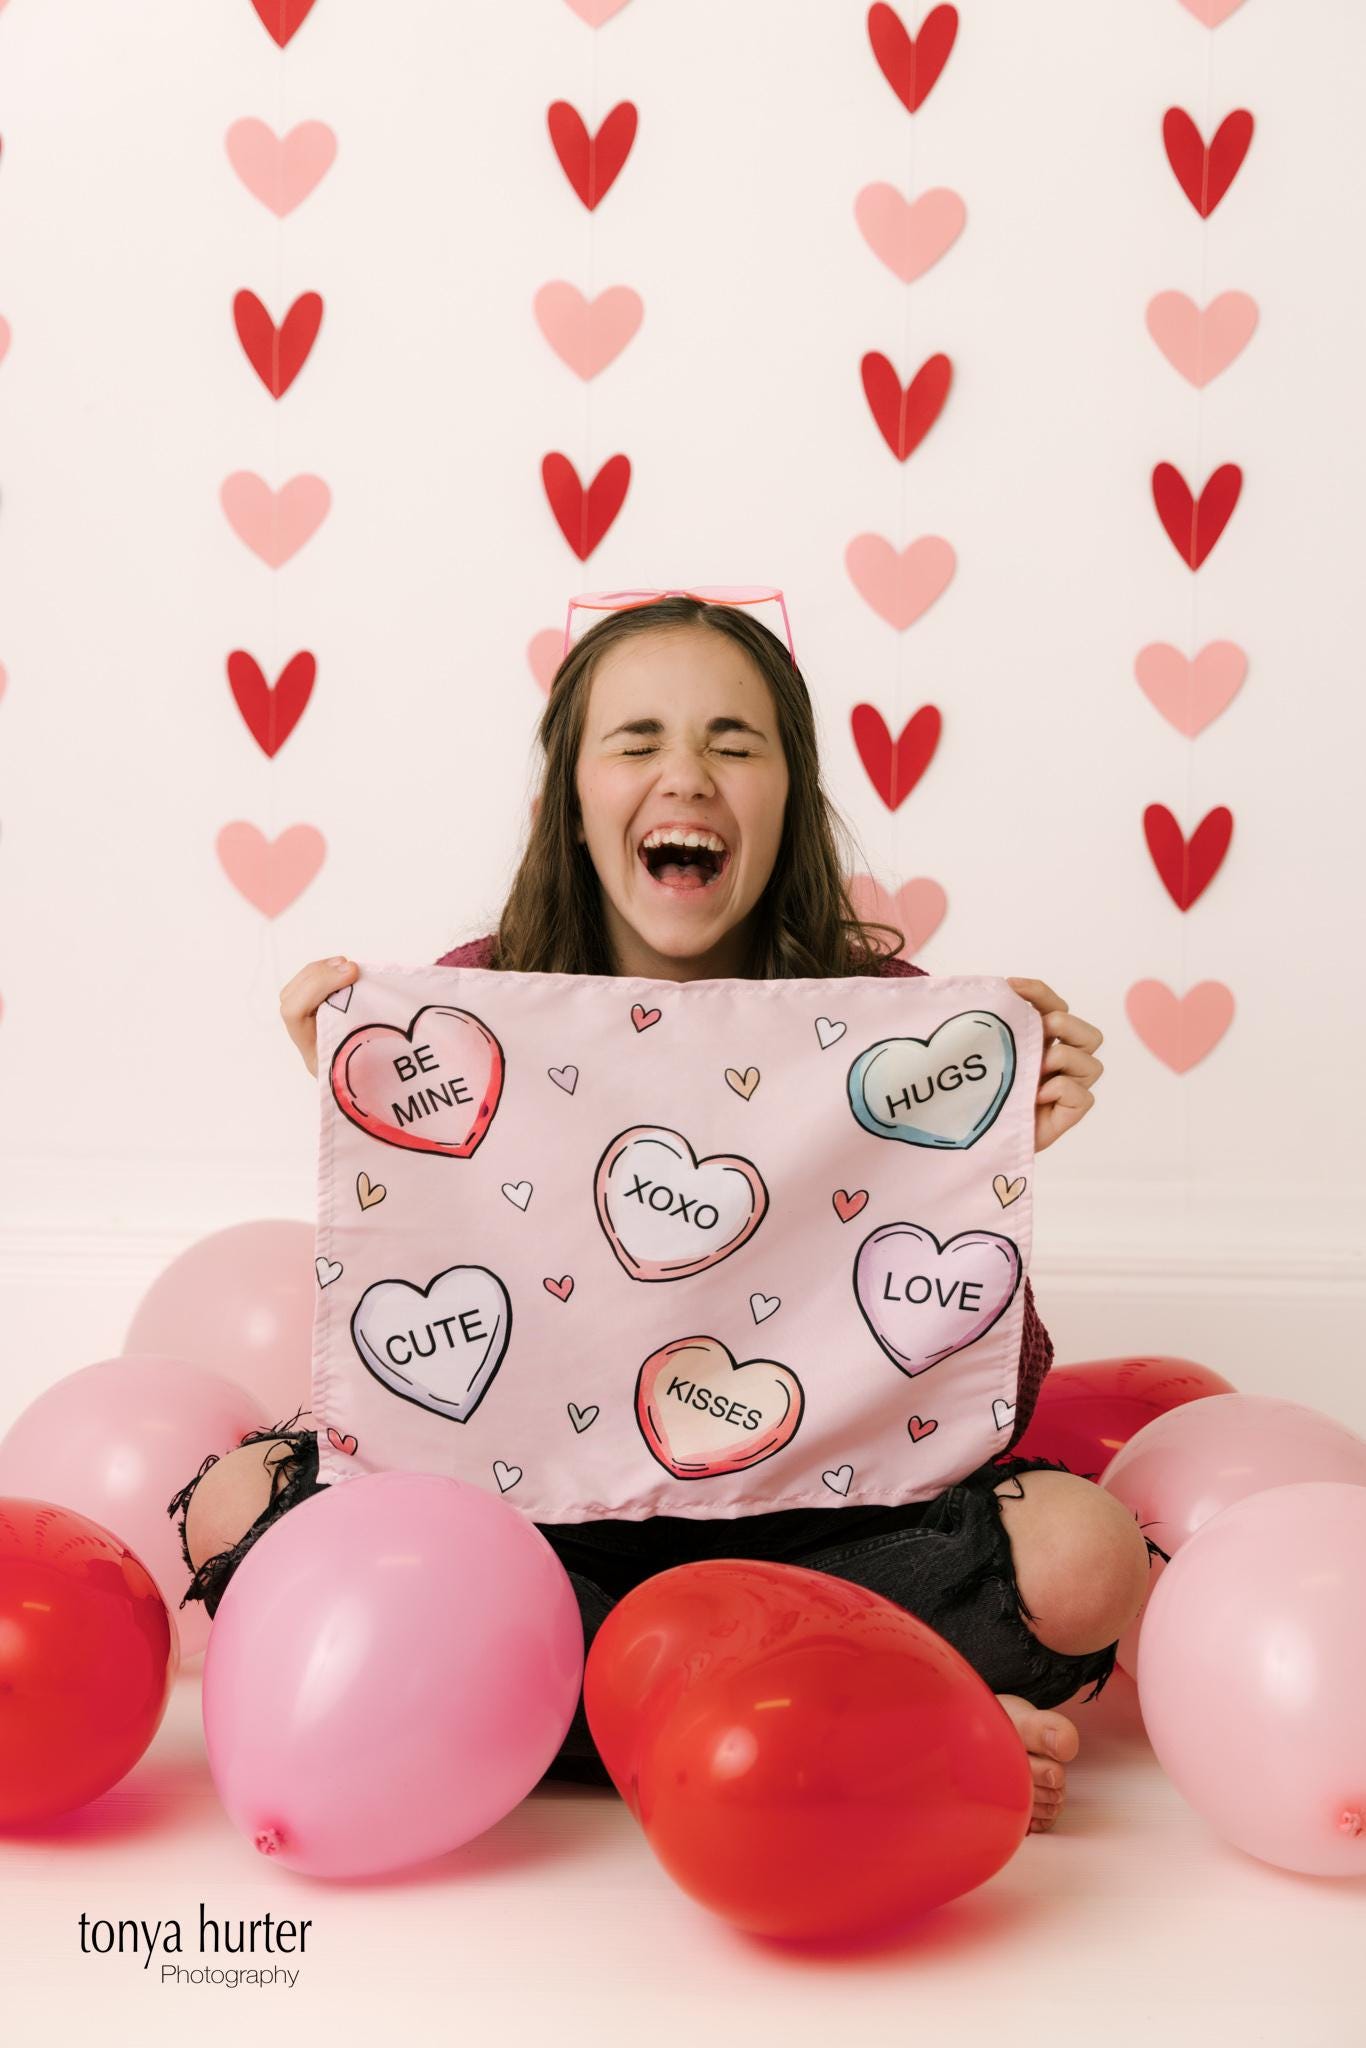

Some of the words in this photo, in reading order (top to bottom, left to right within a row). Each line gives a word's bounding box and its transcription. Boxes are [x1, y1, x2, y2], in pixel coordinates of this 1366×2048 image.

[392, 1044, 440, 1083] BE
[885, 1053, 987, 1119] HUGS
[391, 1077, 474, 1128] MINE
[623, 1174, 719, 1230] XOXO
[883, 1271, 984, 1312] LOVE
[385, 1308, 488, 1366] CUTE
[666, 1376, 763, 1431] KISSES
